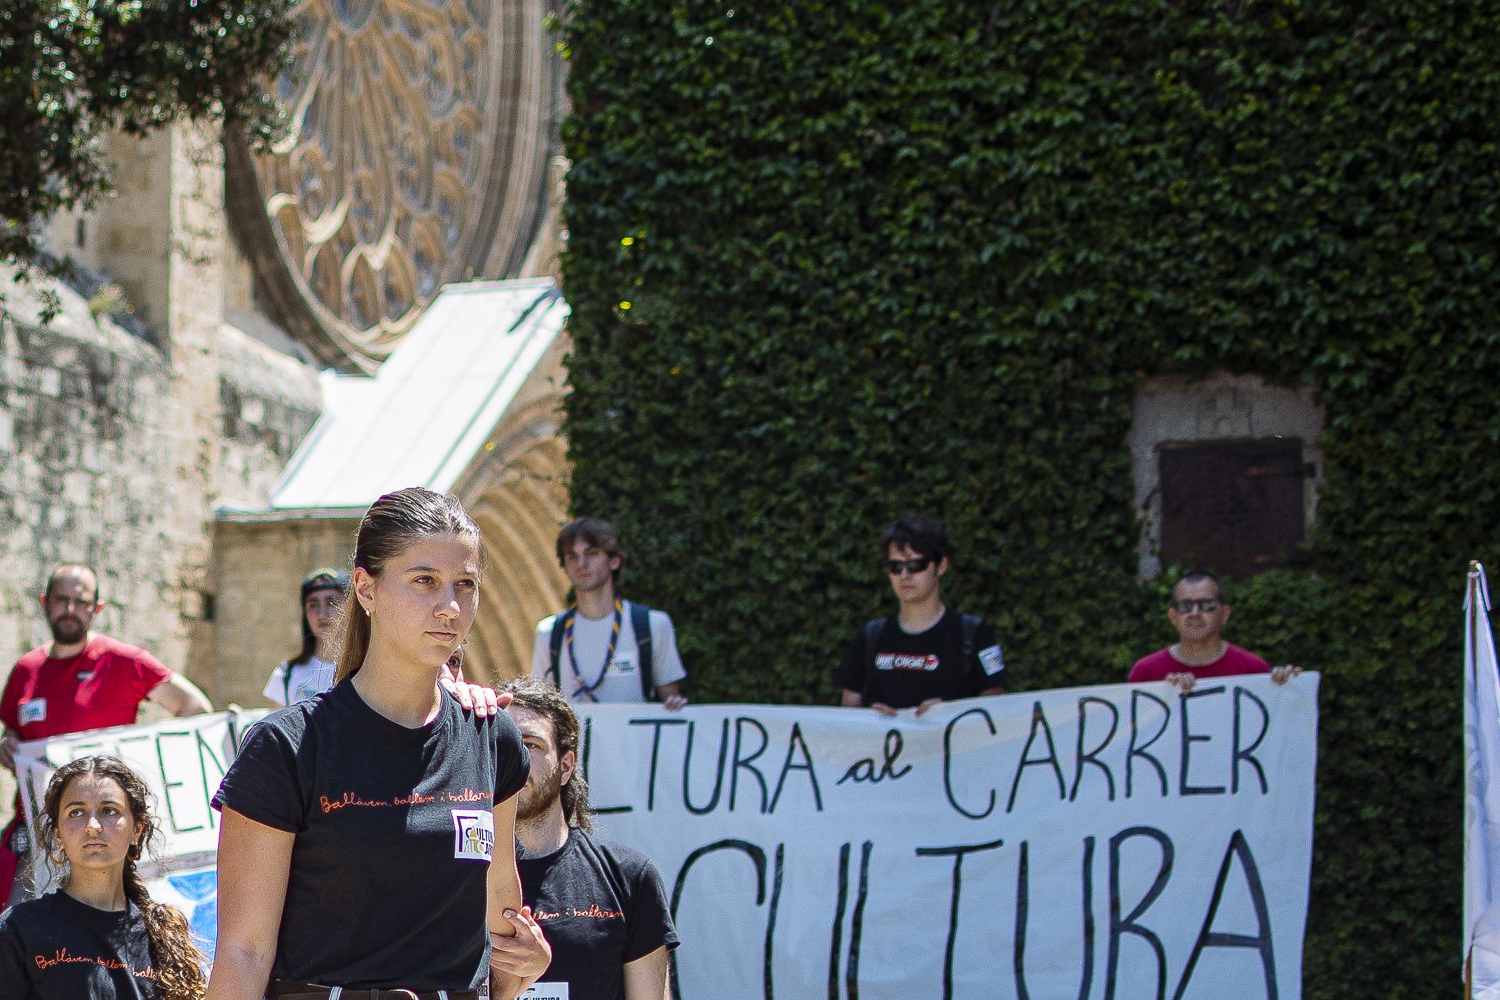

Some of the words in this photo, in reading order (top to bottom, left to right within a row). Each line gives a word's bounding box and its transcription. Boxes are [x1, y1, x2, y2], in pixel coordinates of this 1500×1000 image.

[583, 715, 824, 816] LTURA
[836, 728, 913, 785] al
[943, 686, 1270, 820] CARRER
